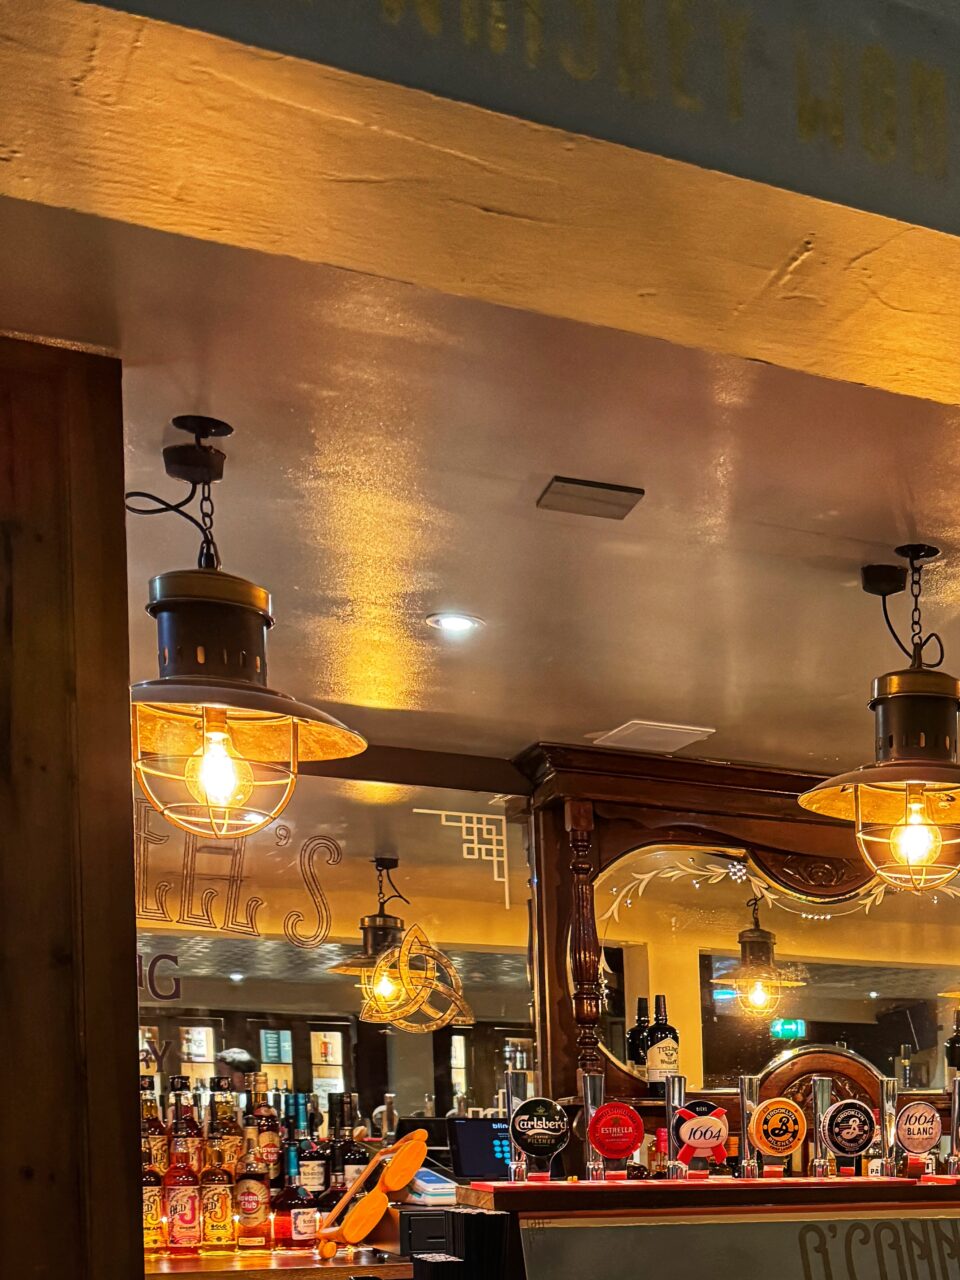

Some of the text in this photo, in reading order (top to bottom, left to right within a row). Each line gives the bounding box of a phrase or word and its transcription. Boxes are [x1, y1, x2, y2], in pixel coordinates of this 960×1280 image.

[766, 1108, 796, 1120] BROOKLYN
[837, 1109, 866, 1123] BROOKLYN
[904, 1112, 936, 1126] 1664
[515, 1114, 568, 1133] Carlsberg
[601, 1126, 633, 1134] ESTRELLA
[688, 1125, 723, 1141] 1664
[907, 1127, 934, 1136] BLANC
